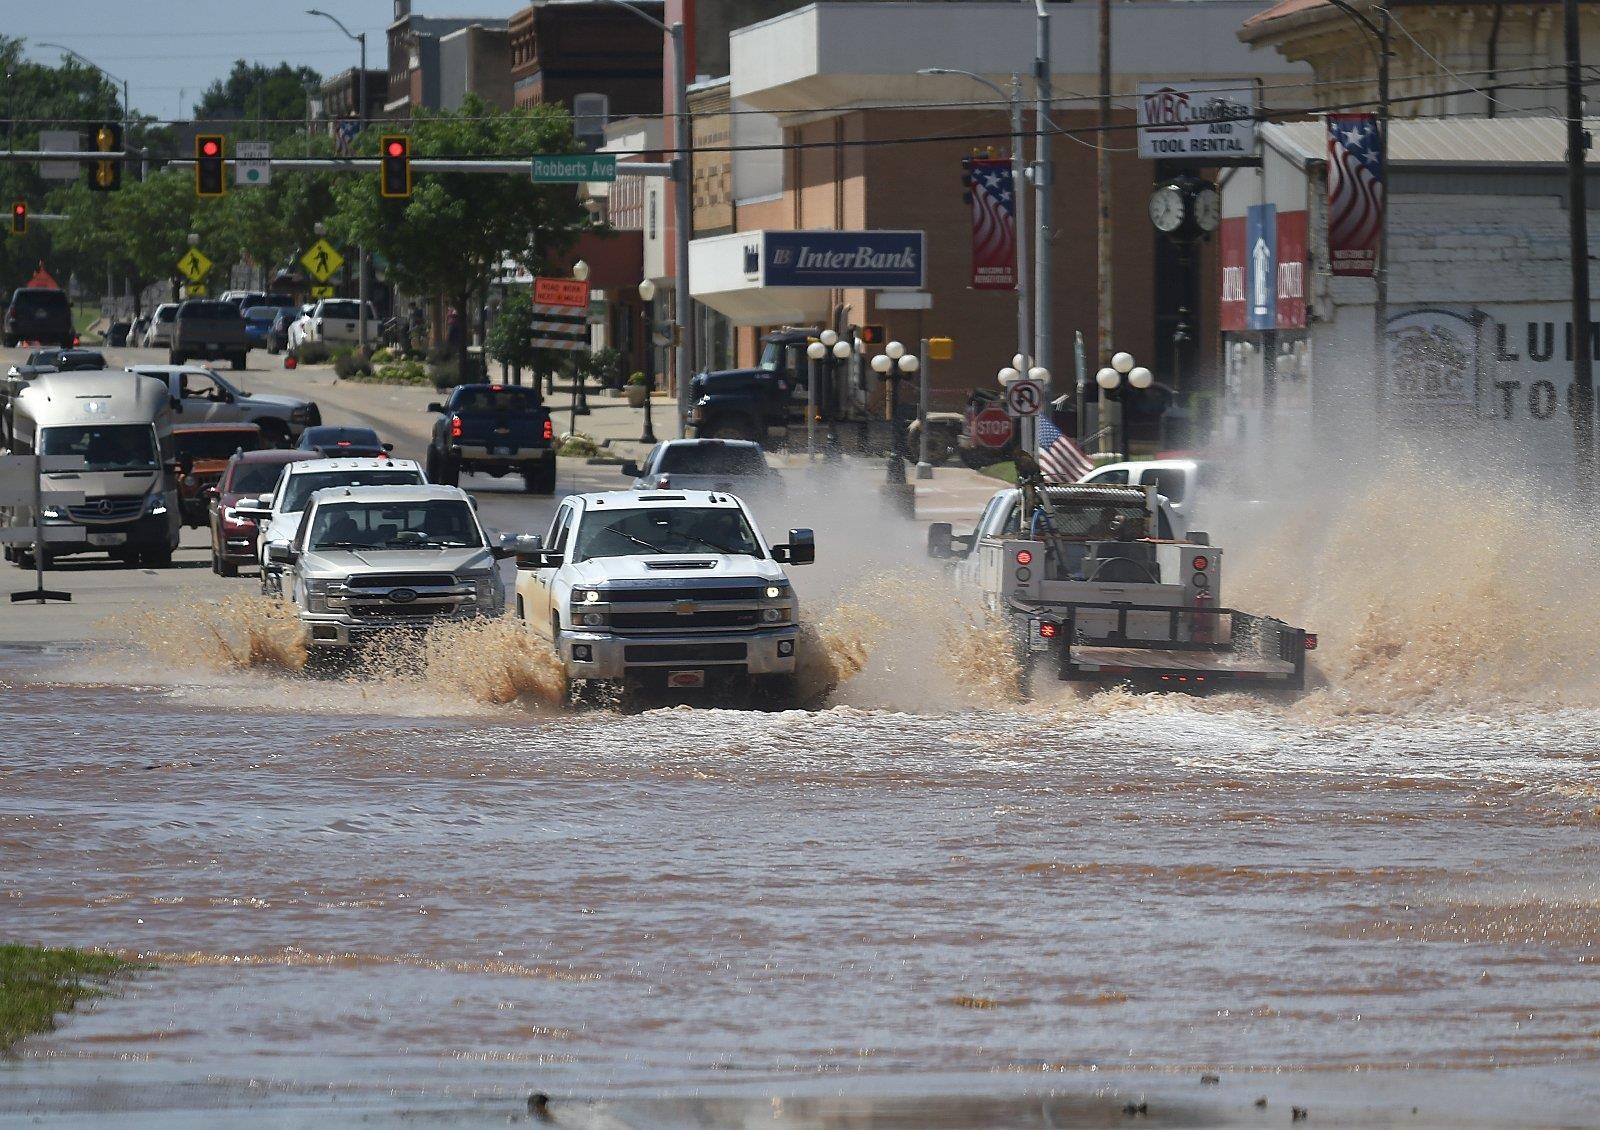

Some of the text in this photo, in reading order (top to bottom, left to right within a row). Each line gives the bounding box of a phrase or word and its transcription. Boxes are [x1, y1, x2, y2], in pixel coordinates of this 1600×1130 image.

[1208, 123, 1232, 134] AND
[1151, 138, 1245, 152] TOOL RENTAL
[534, 161, 613, 176] Robberts Ave
[795, 246, 916, 269] InterBank
[977, 421, 1009, 435] STOP
